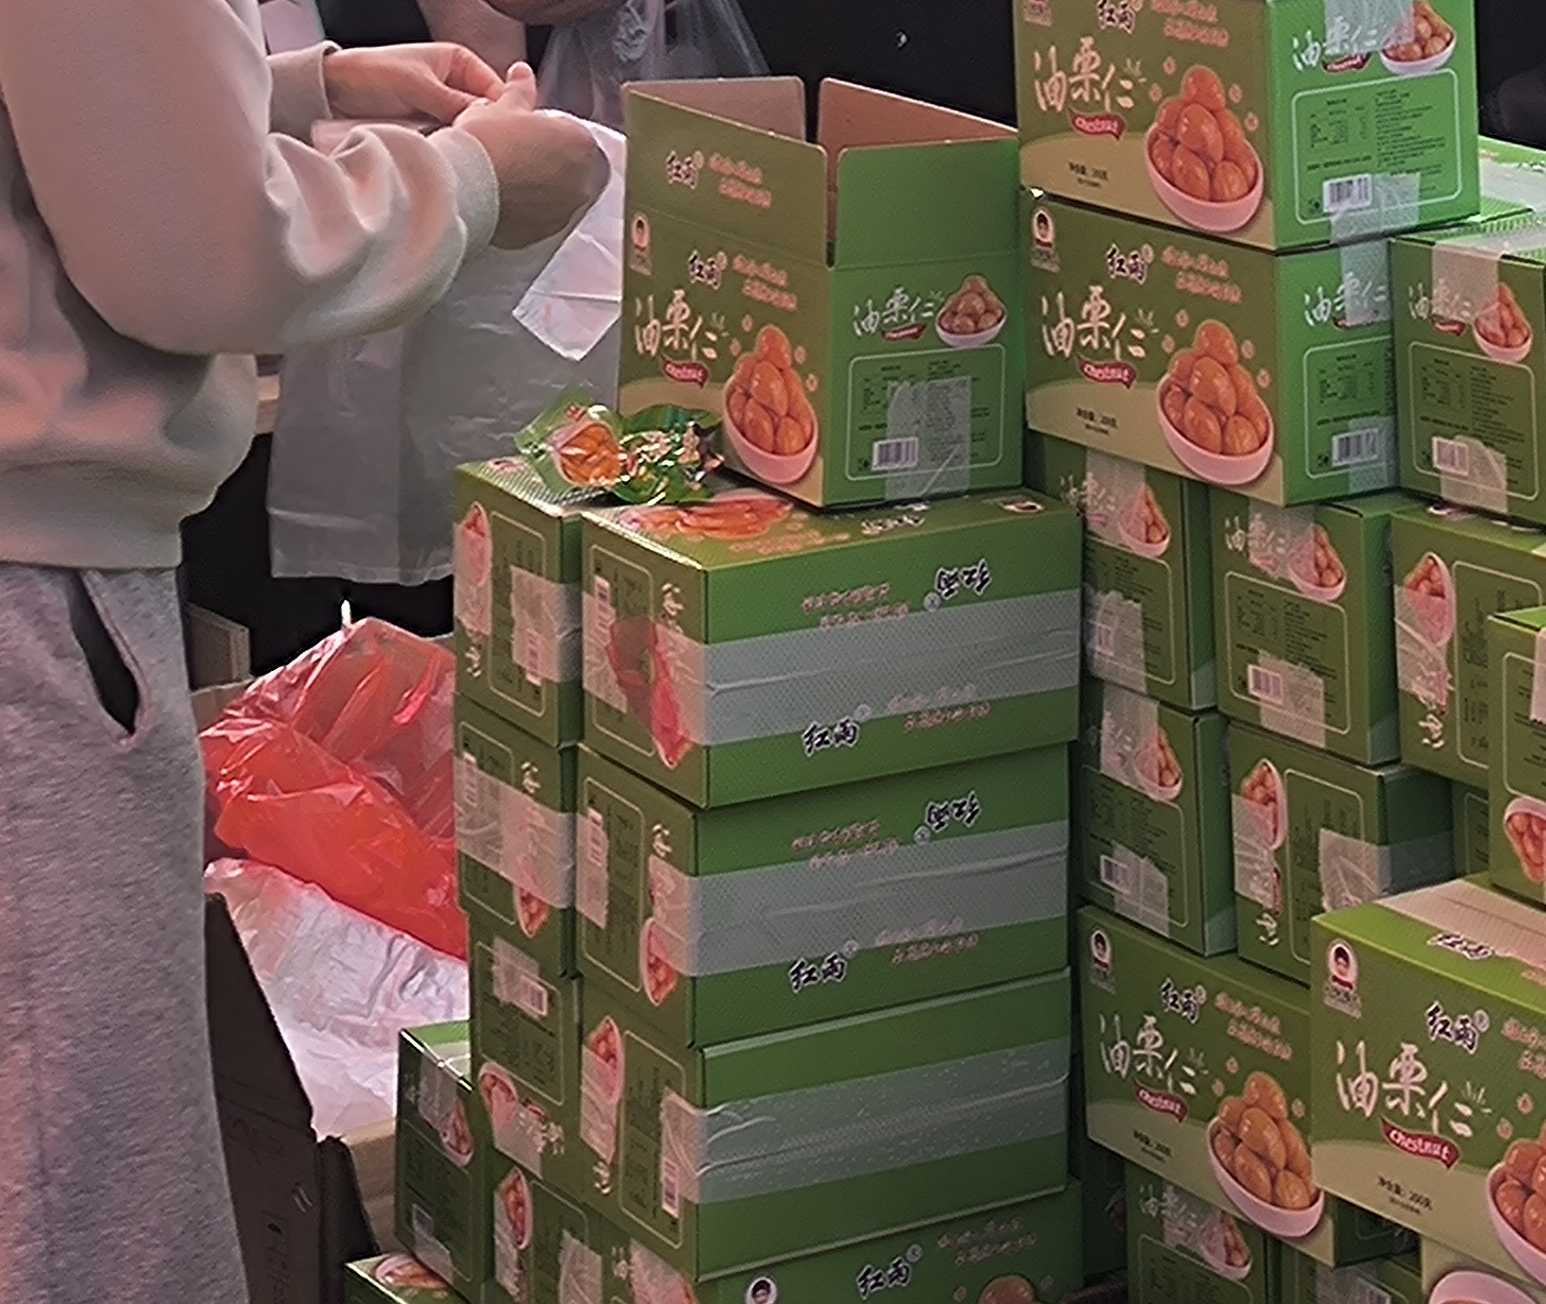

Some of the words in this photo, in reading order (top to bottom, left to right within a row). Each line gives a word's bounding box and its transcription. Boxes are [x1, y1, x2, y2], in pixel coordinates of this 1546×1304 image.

[1034, 37, 1138, 113] 油栗仁
[635, 289, 718, 361] 油栗仁
[854, 287, 936, 337] 油栗仁
[1042, 285, 1148, 361] 油栗仁
[1097, 1013, 1197, 1096] 油栗仁
[1425, 1001, 1479, 1055] 红雨
[1335, 1041, 1474, 1139] 油栗仁
